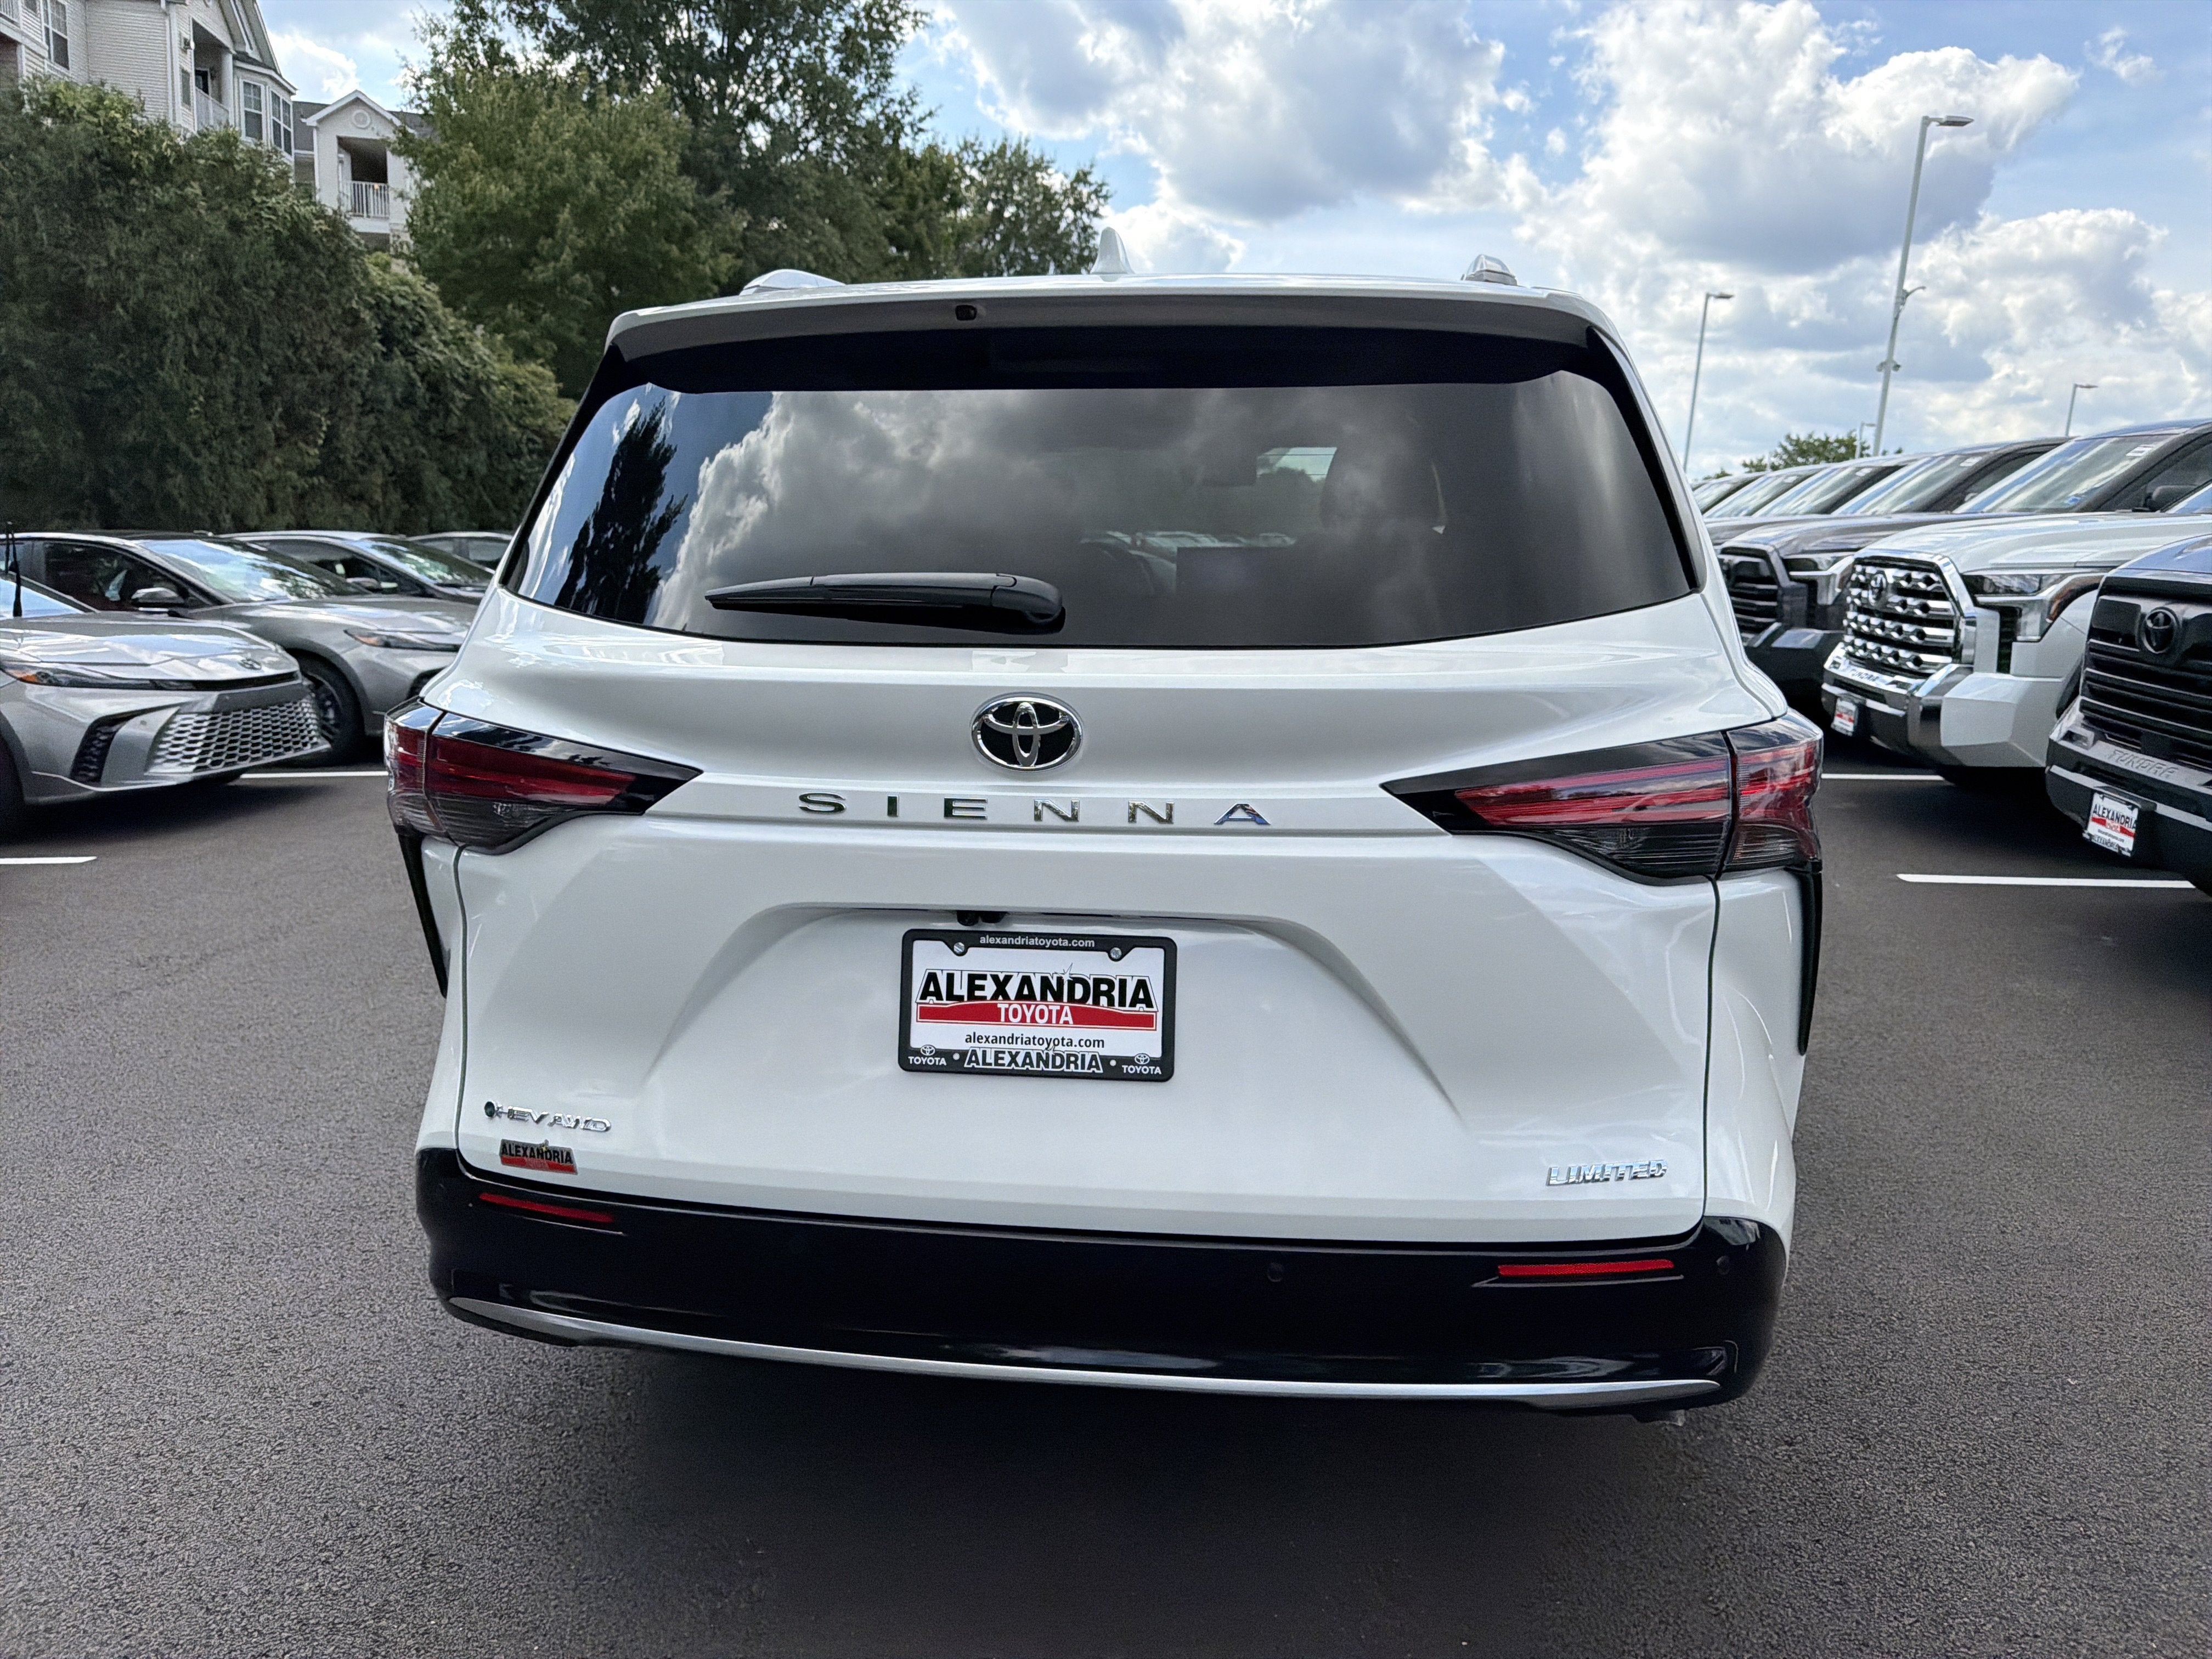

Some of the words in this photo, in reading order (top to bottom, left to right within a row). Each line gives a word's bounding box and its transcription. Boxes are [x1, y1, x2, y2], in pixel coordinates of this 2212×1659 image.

[798, 792, 1271, 825] SIENNA
[2092, 803, 2137, 830] ALEXANDRIA
[979, 935, 1096, 948] alexandriatoyota.com
[917, 970, 1157, 1010] ALEXANDRIA
[997, 1003, 1074, 1025] TOYOTA
[964, 1032, 1105, 1049] alexandriatoyota.com
[908, 1056, 947, 1066] TOYOTA
[964, 1048, 1103, 1073] ALEXANDRIA
[1121, 1064, 1162, 1075] TOYOTA
[501, 1142, 574, 1164] ALEXANDRIA
[1545, 1159, 1668, 1187] LIMITED
